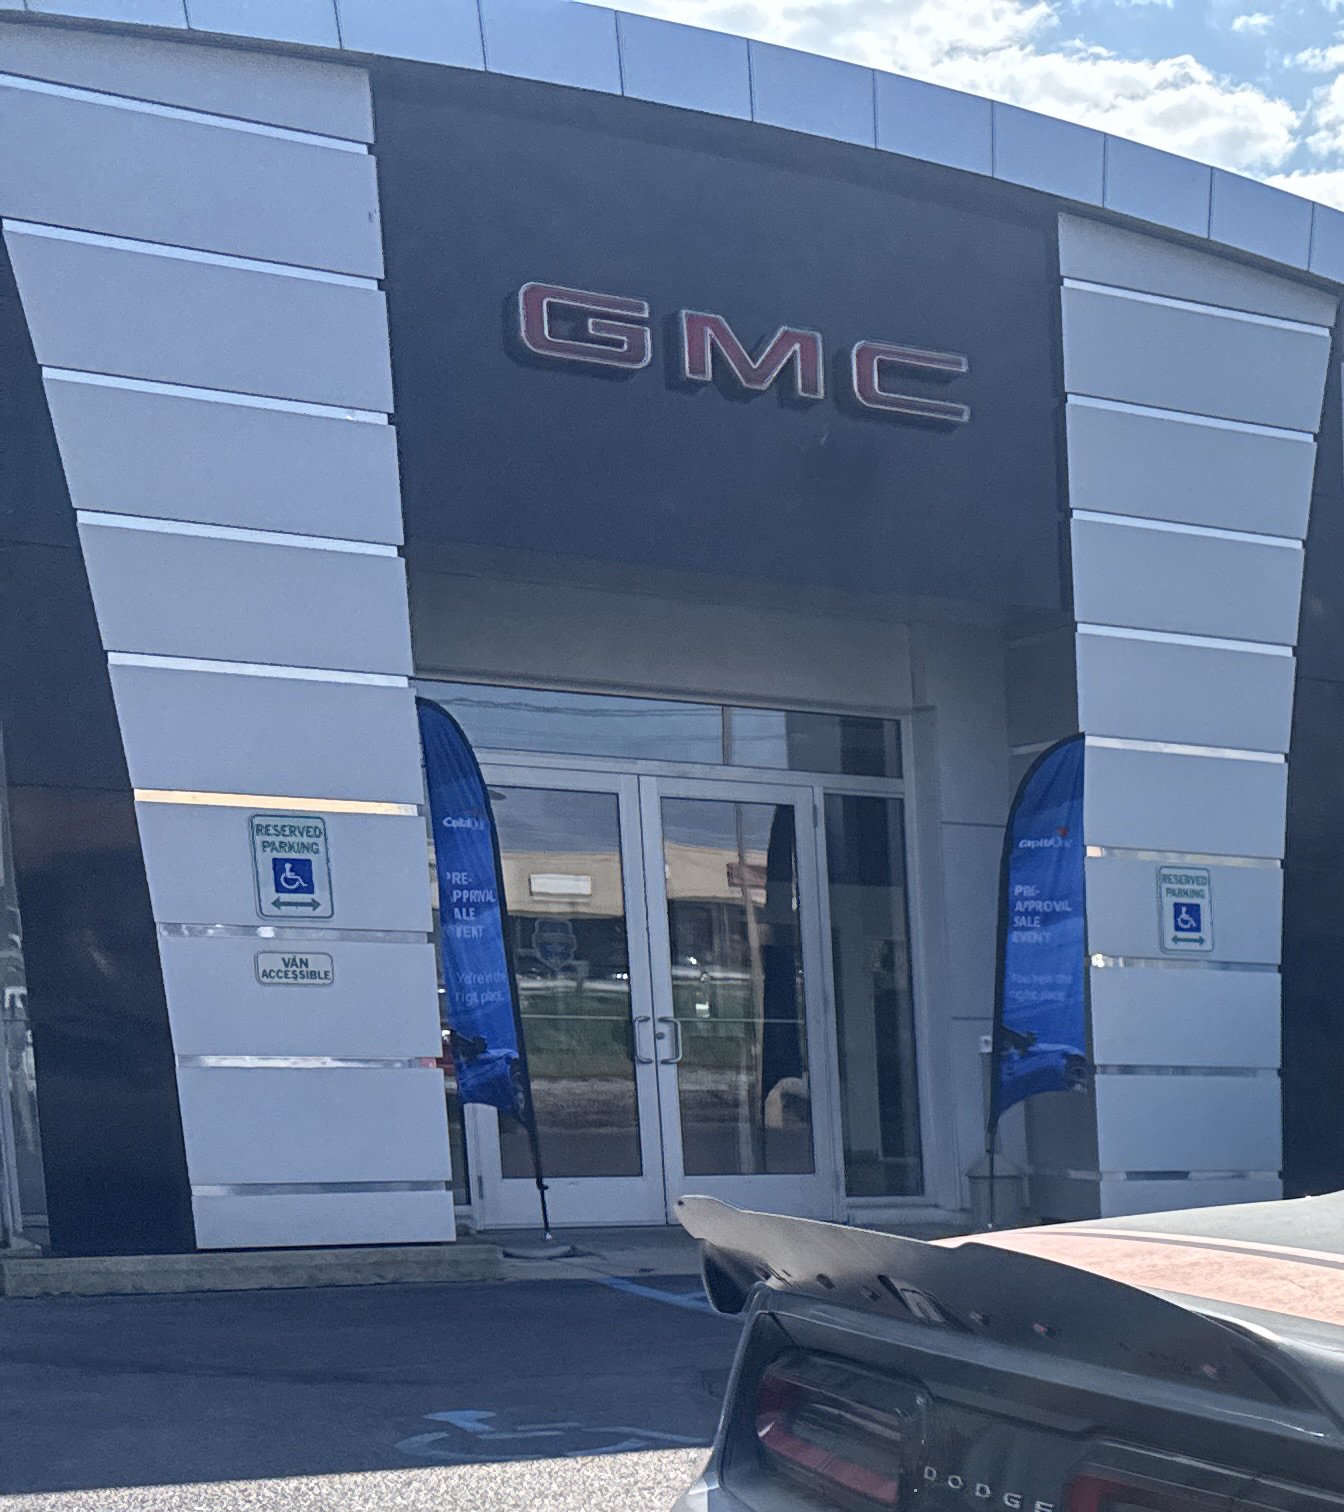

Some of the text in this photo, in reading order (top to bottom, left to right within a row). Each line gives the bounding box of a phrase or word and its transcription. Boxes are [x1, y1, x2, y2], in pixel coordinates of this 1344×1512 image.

[518, 280, 970, 423] GMC
[255, 823, 323, 839] RESERVED
[261, 840, 320, 855] PARKING
[1162, 873, 1208, 886] RESERVED
[453, 907, 476, 920] ALE
[281, 955, 309, 969] VAN
[260, 968, 331, 981] ACCESSIBLE
